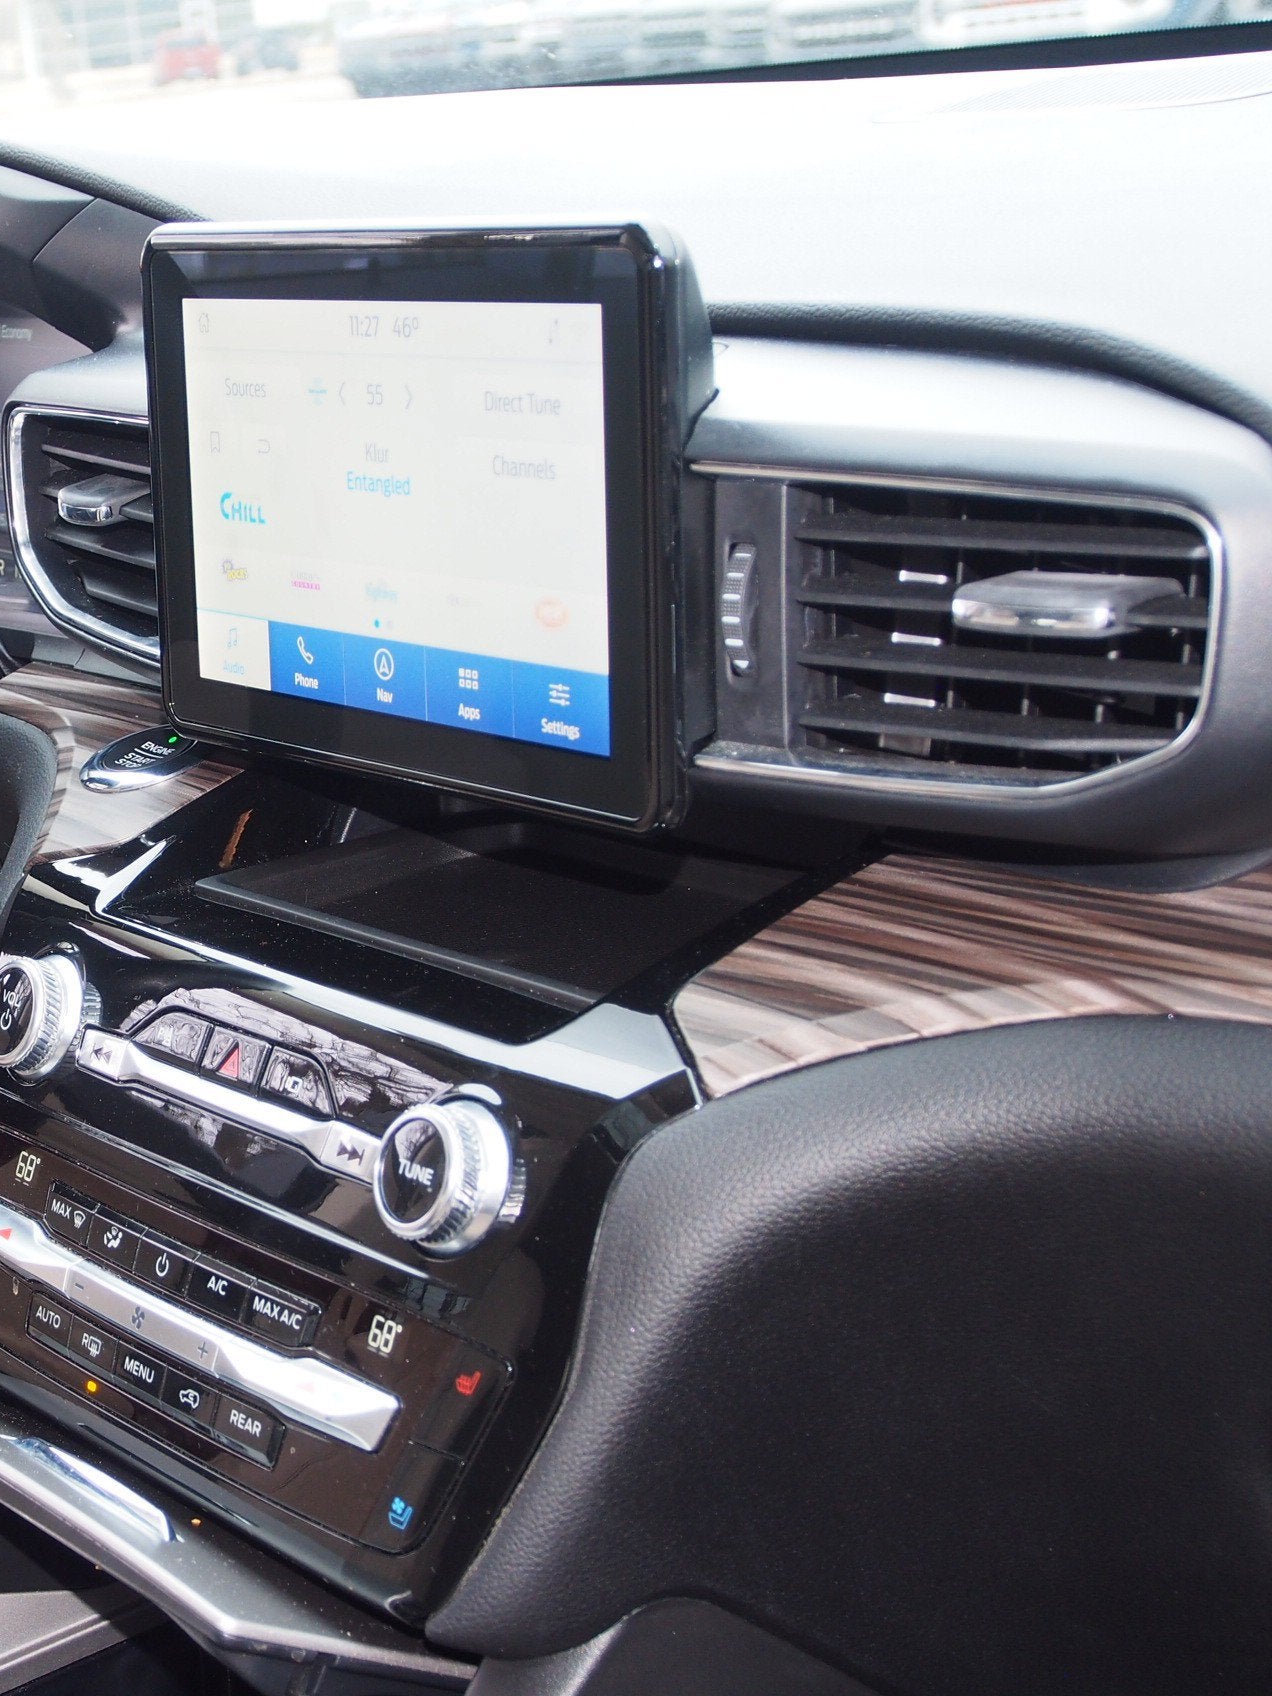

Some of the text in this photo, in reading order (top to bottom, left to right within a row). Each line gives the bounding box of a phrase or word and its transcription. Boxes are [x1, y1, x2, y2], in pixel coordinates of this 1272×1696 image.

[348, 315, 380, 337] 11:27
[224, 378, 267, 399] Sources
[366, 384, 384, 406] 55
[484, 390, 561, 416] Direct Tune
[364, 442, 389, 464] Klur
[492, 454, 556, 480] Channels
[346, 471, 411, 497] Entangled
[223, 660, 245, 675] Audio
[294, 672, 319, 690] Phone
[376, 687, 393, 704] Nav
[458, 703, 481, 721] Apps
[540, 717, 581, 740] Settings
[141, 741, 175, 756] ENGINE
[3, 988, 22, 1008] VOL
[398, 1158, 434, 1186] TUNE
[51, 1198, 72, 1220] MAX
[207, 1275, 228, 1296] A/C
[36, 1305, 61, 1329] AUTO
[253, 1295, 302, 1330] MAX A/C
[124, 1356, 155, 1383] MENU
[229, 1409, 262, 1438] REAR
